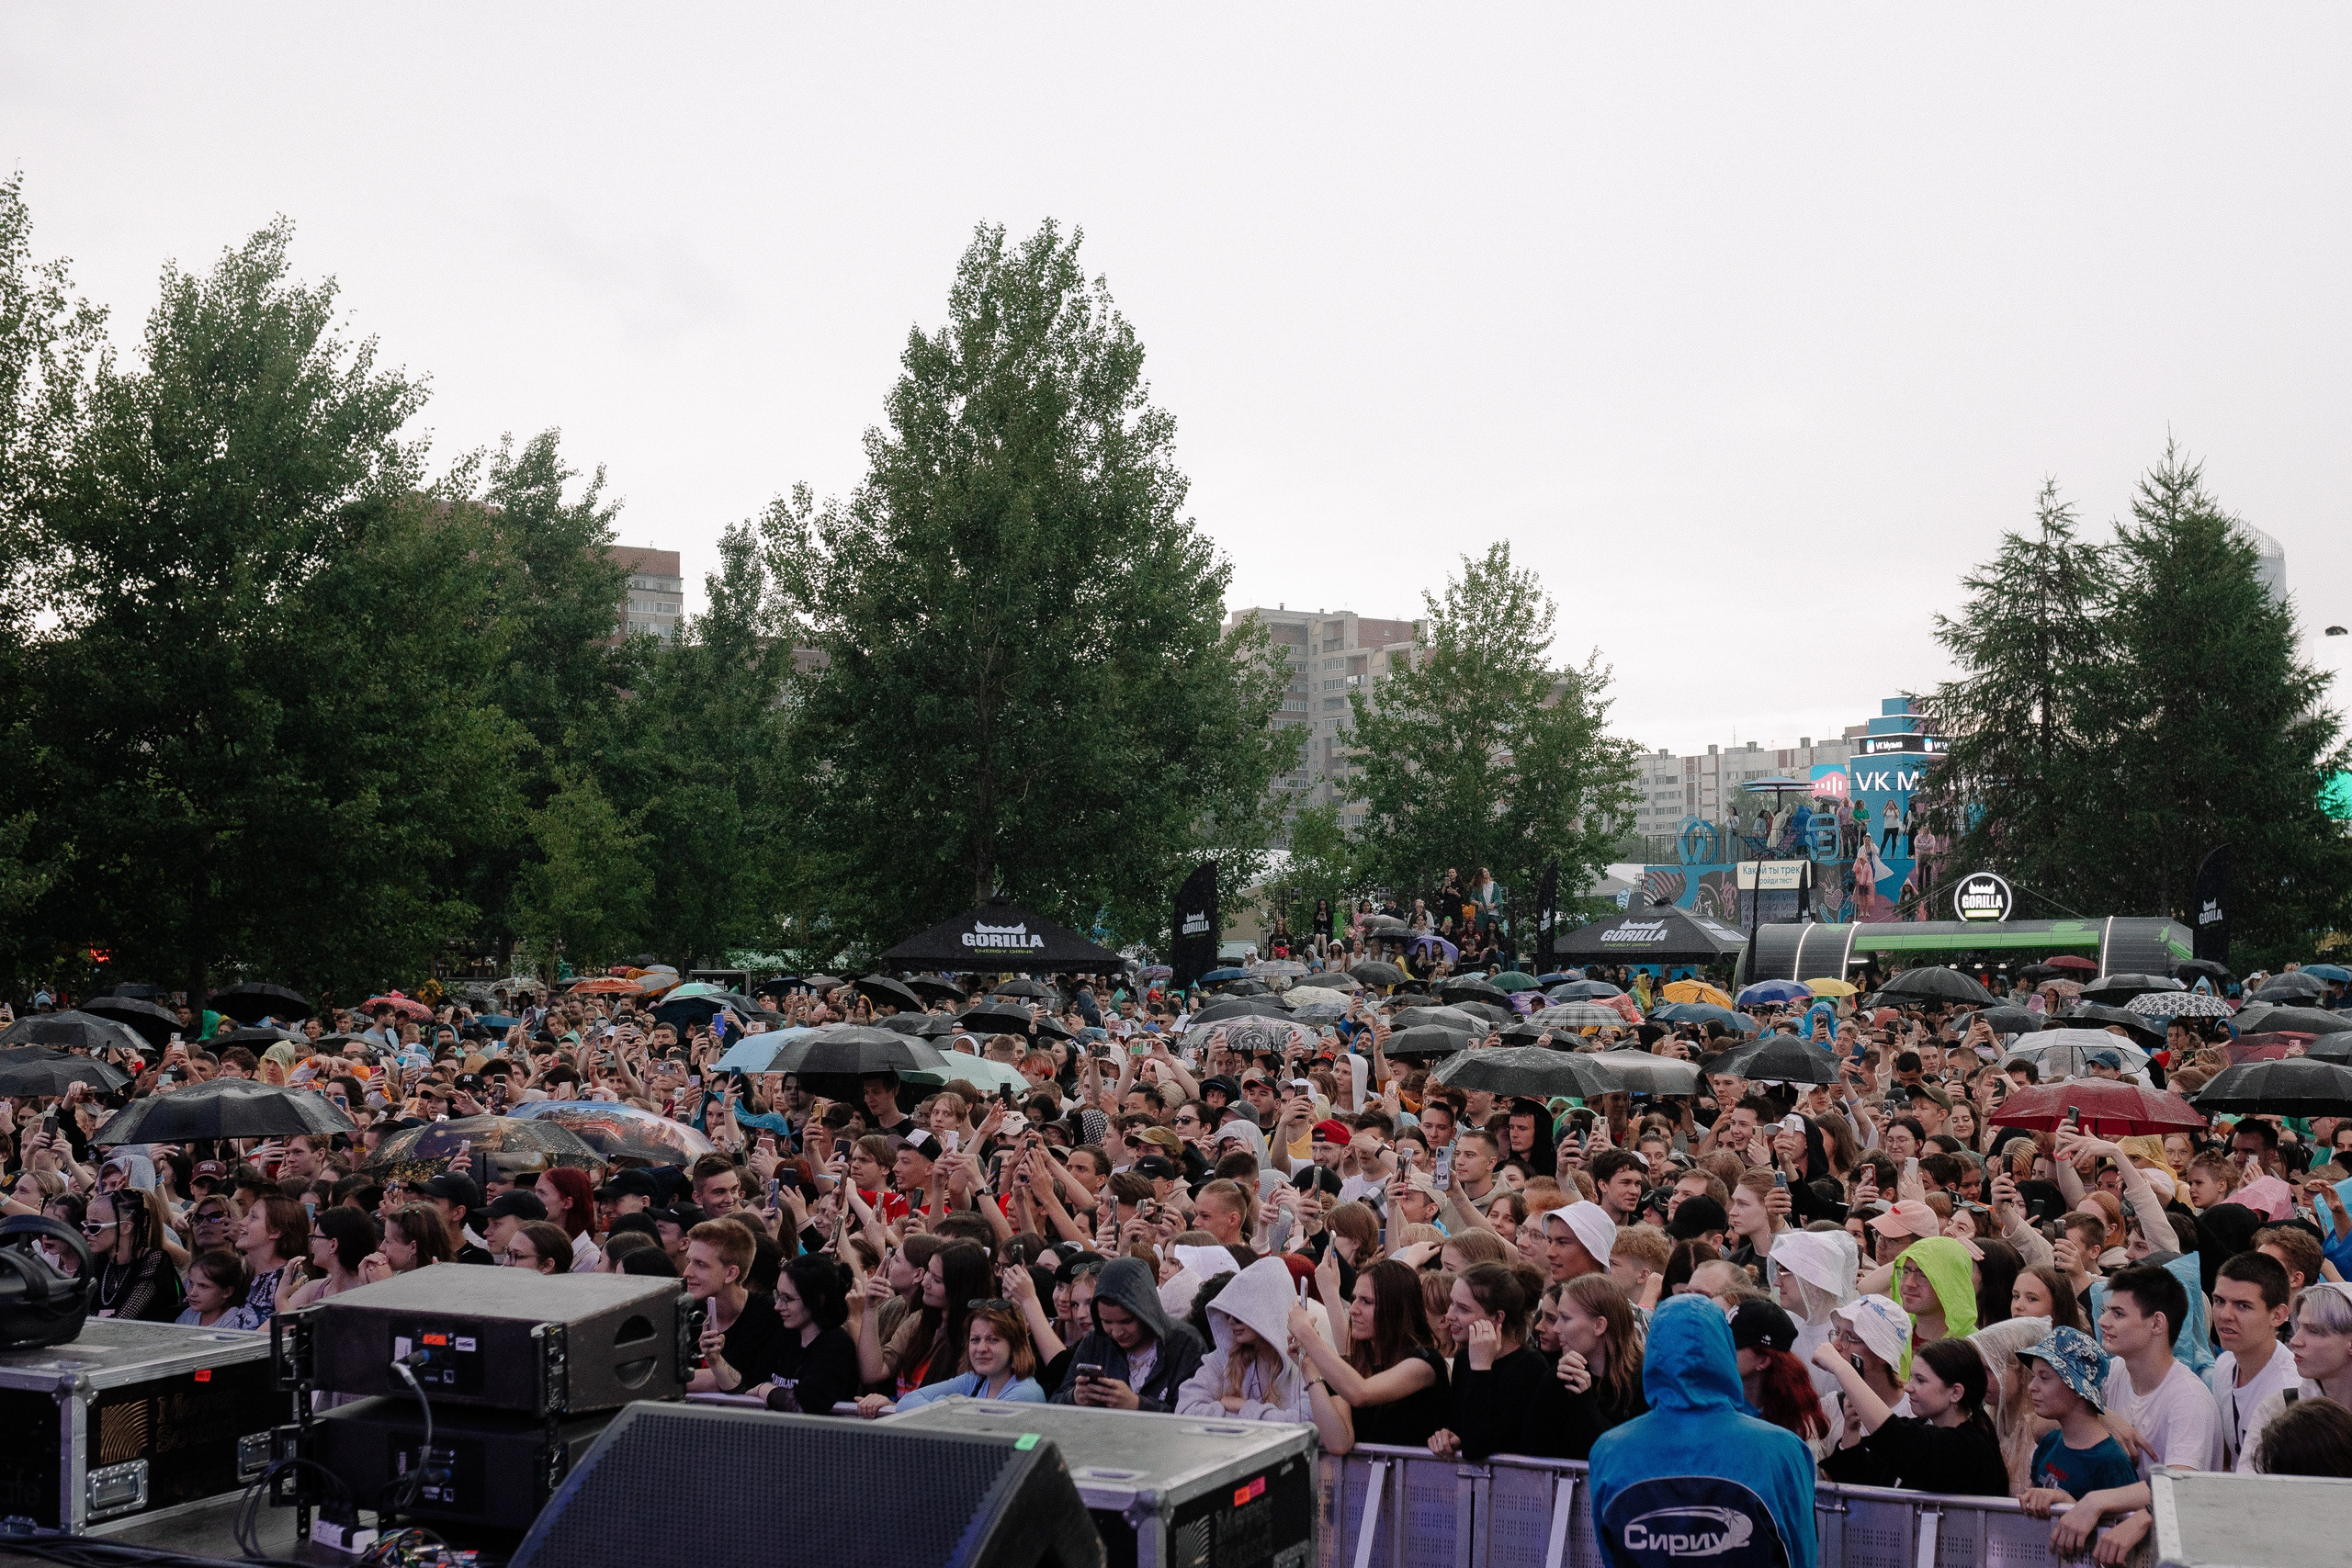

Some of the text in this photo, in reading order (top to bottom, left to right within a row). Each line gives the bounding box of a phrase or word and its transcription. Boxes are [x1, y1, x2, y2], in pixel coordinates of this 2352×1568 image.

[1856, 772, 1890, 792] VK
[1769, 866, 1779, 874] ты
[1962, 895, 2003, 908] GORILLA
[1182, 920, 1210, 935] GORILLA
[962, 933, 1045, 948] GORILLA
[1600, 930, 1668, 942] GORILLA
